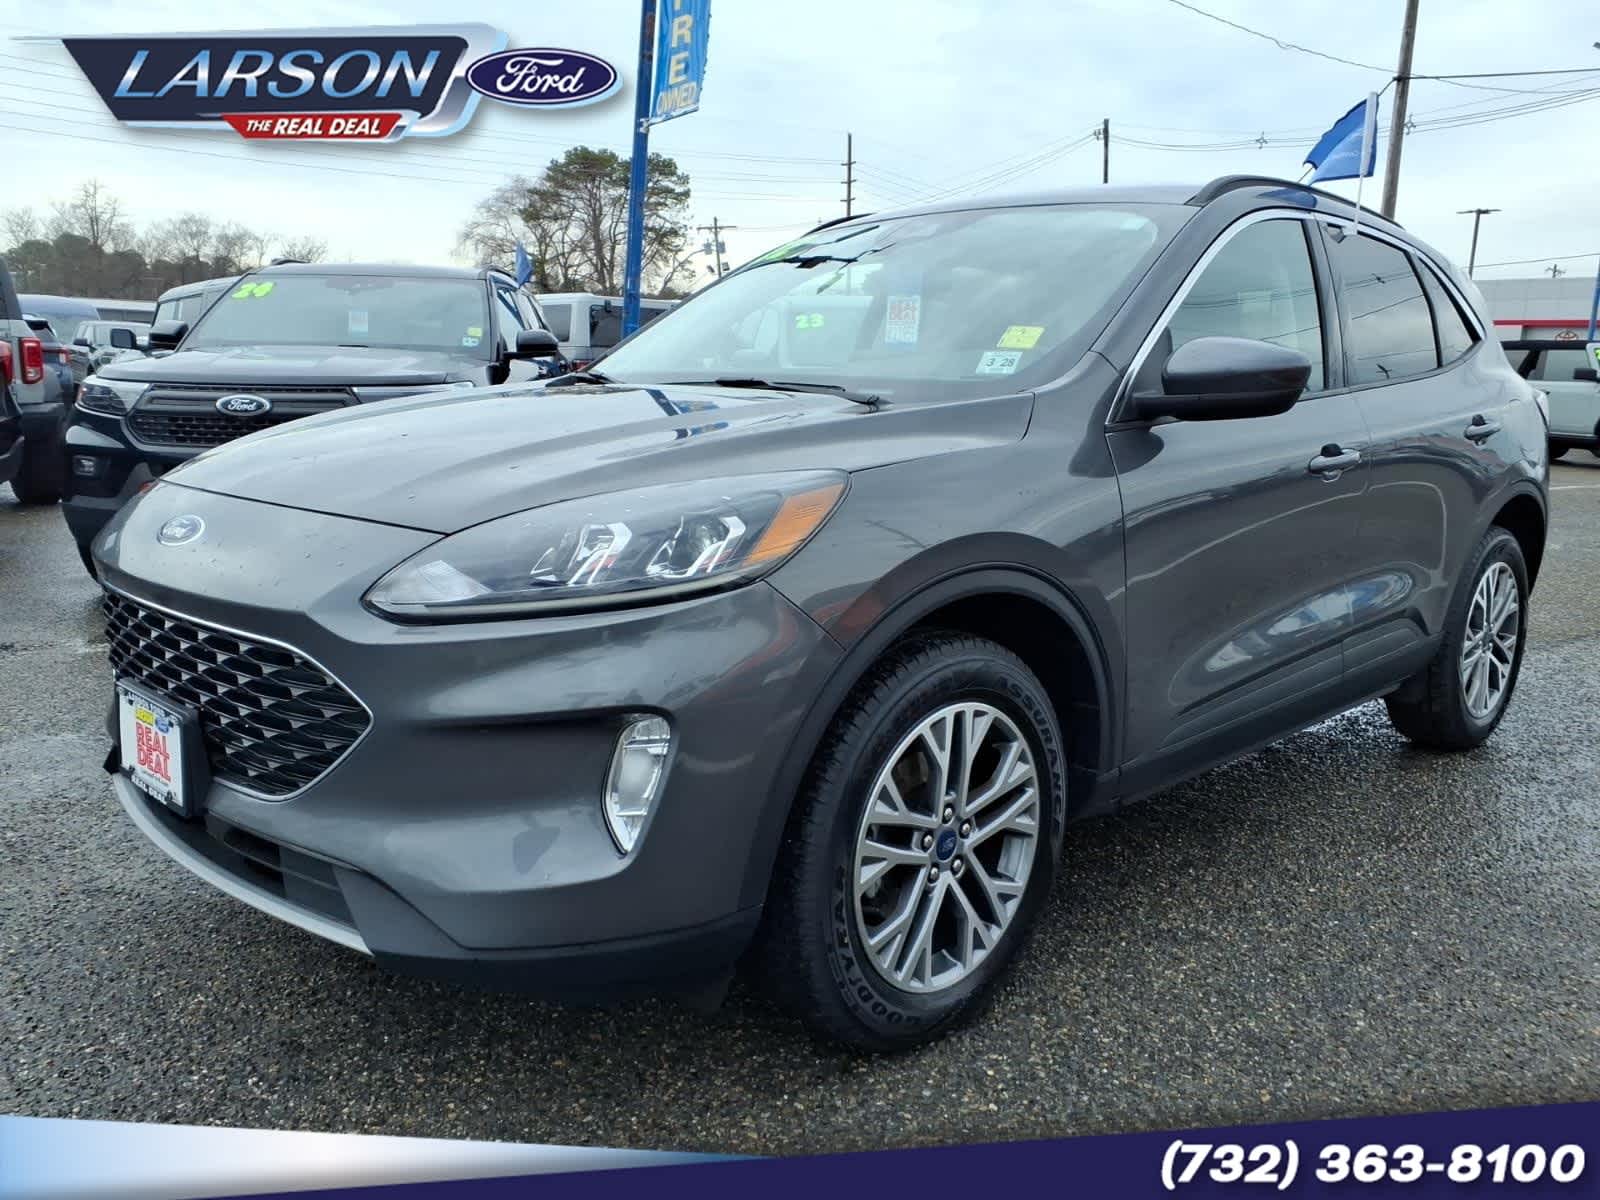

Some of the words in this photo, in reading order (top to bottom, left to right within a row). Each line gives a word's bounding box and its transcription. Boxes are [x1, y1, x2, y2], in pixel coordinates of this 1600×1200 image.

[669, 0, 693, 85] RE
[656, 81, 698, 115] OWNED
[795, 313, 825, 329] 23
[227, 398, 257, 411] Ford
[135, 721, 171, 760] REAL
[137, 744, 172, 783] DEAL
